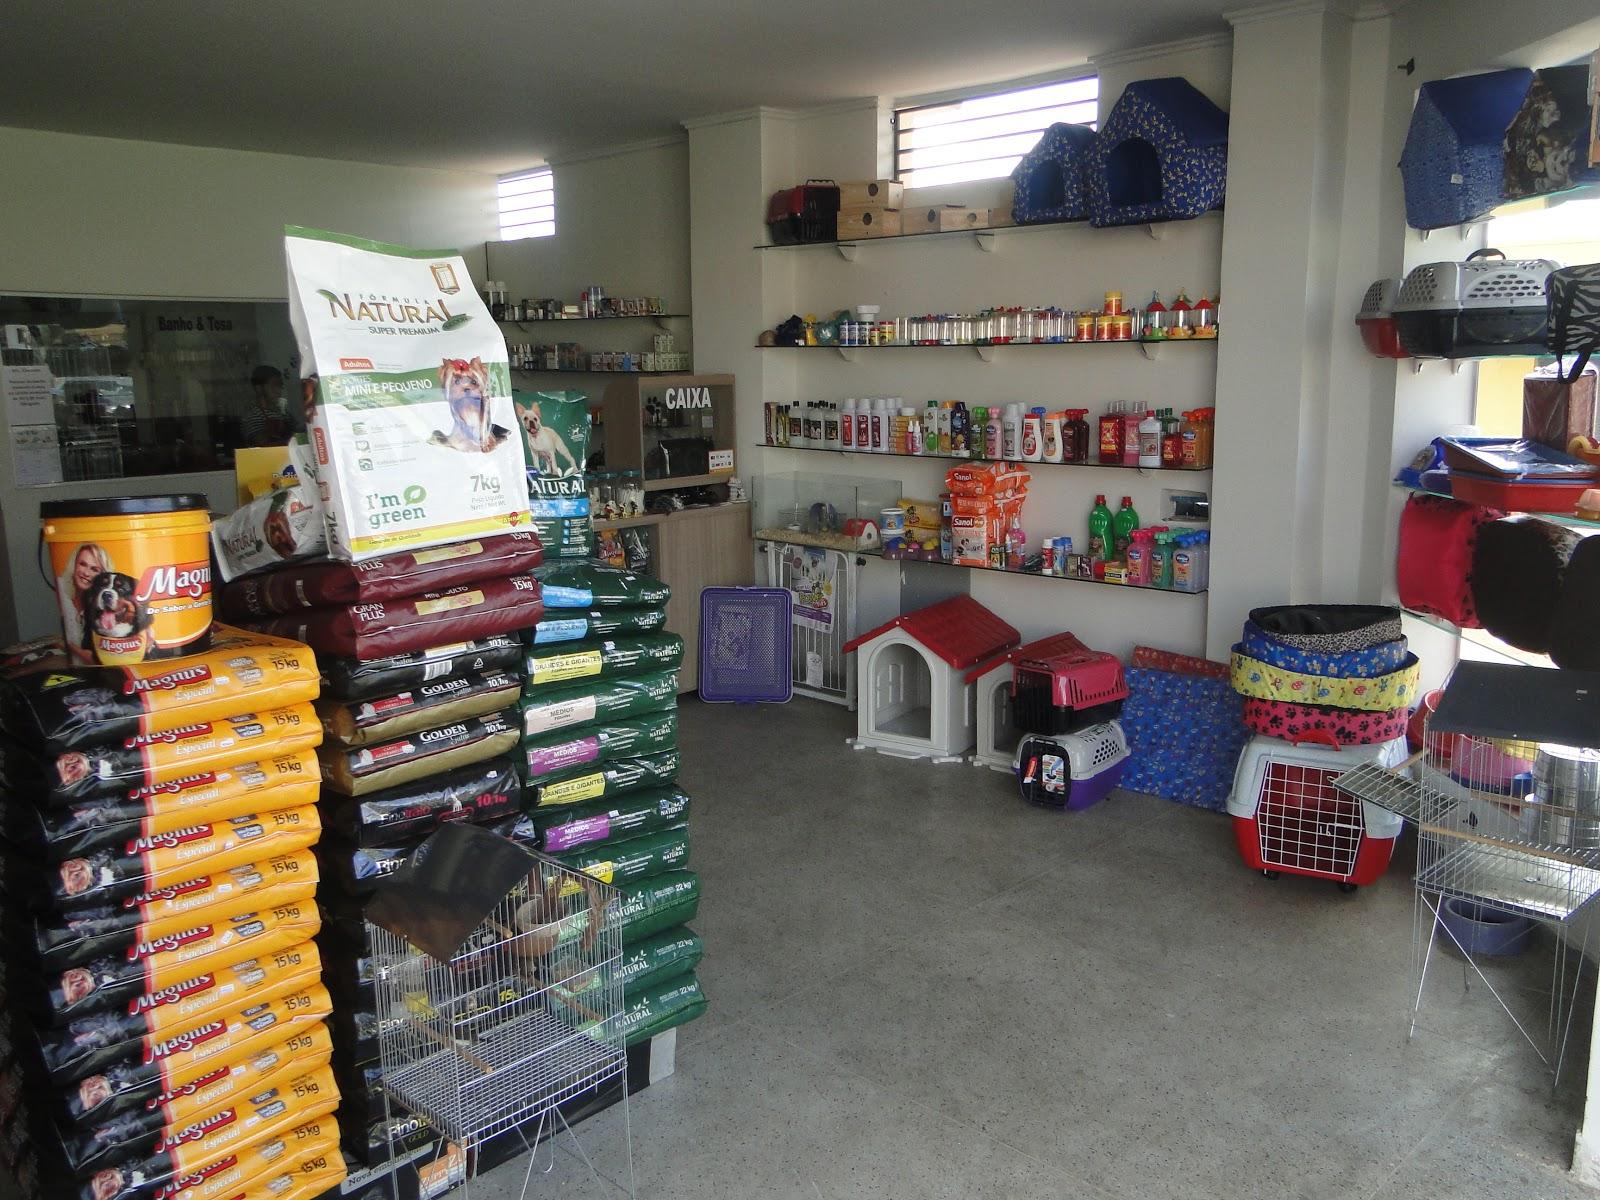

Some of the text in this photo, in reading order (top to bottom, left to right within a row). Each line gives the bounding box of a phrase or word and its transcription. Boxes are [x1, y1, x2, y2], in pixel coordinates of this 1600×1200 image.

[328, 293, 456, 325] NATURAL
[159, 316, 232, 331] Banho & Tosa
[368, 326, 440, 336] SUPER PREMIUM
[345, 381, 374, 396] MINI
[382, 379, 433, 394] PEQUENO
[665, 387, 712, 409] CAIXA
[470, 473, 501, 493] 7kg
[953, 472, 972, 481] Sanol
[528, 479, 587, 494] ATURAL
[368, 506, 426, 530] green
[953, 517, 974, 526] Sanol
[358, 560, 385, 573] PLUS
[513, 578, 534, 591] 15kg
[162, 604, 186, 613] Sabor
[353, 603, 384, 614] GRAN
[360, 611, 386, 622] PLUS
[101, 639, 141, 654] Magnus
[125, 666, 208, 695] Magnus
[420, 678, 470, 696] GOLDEN
[419, 723, 468, 743] GOLDEN
[127, 824, 210, 855] Magnus
[128, 925, 211, 961] Magnus
[130, 974, 211, 1016] Magnus
[145, 1021, 223, 1065] Magnus
[156, 1110, 232, 1154] Magnus
